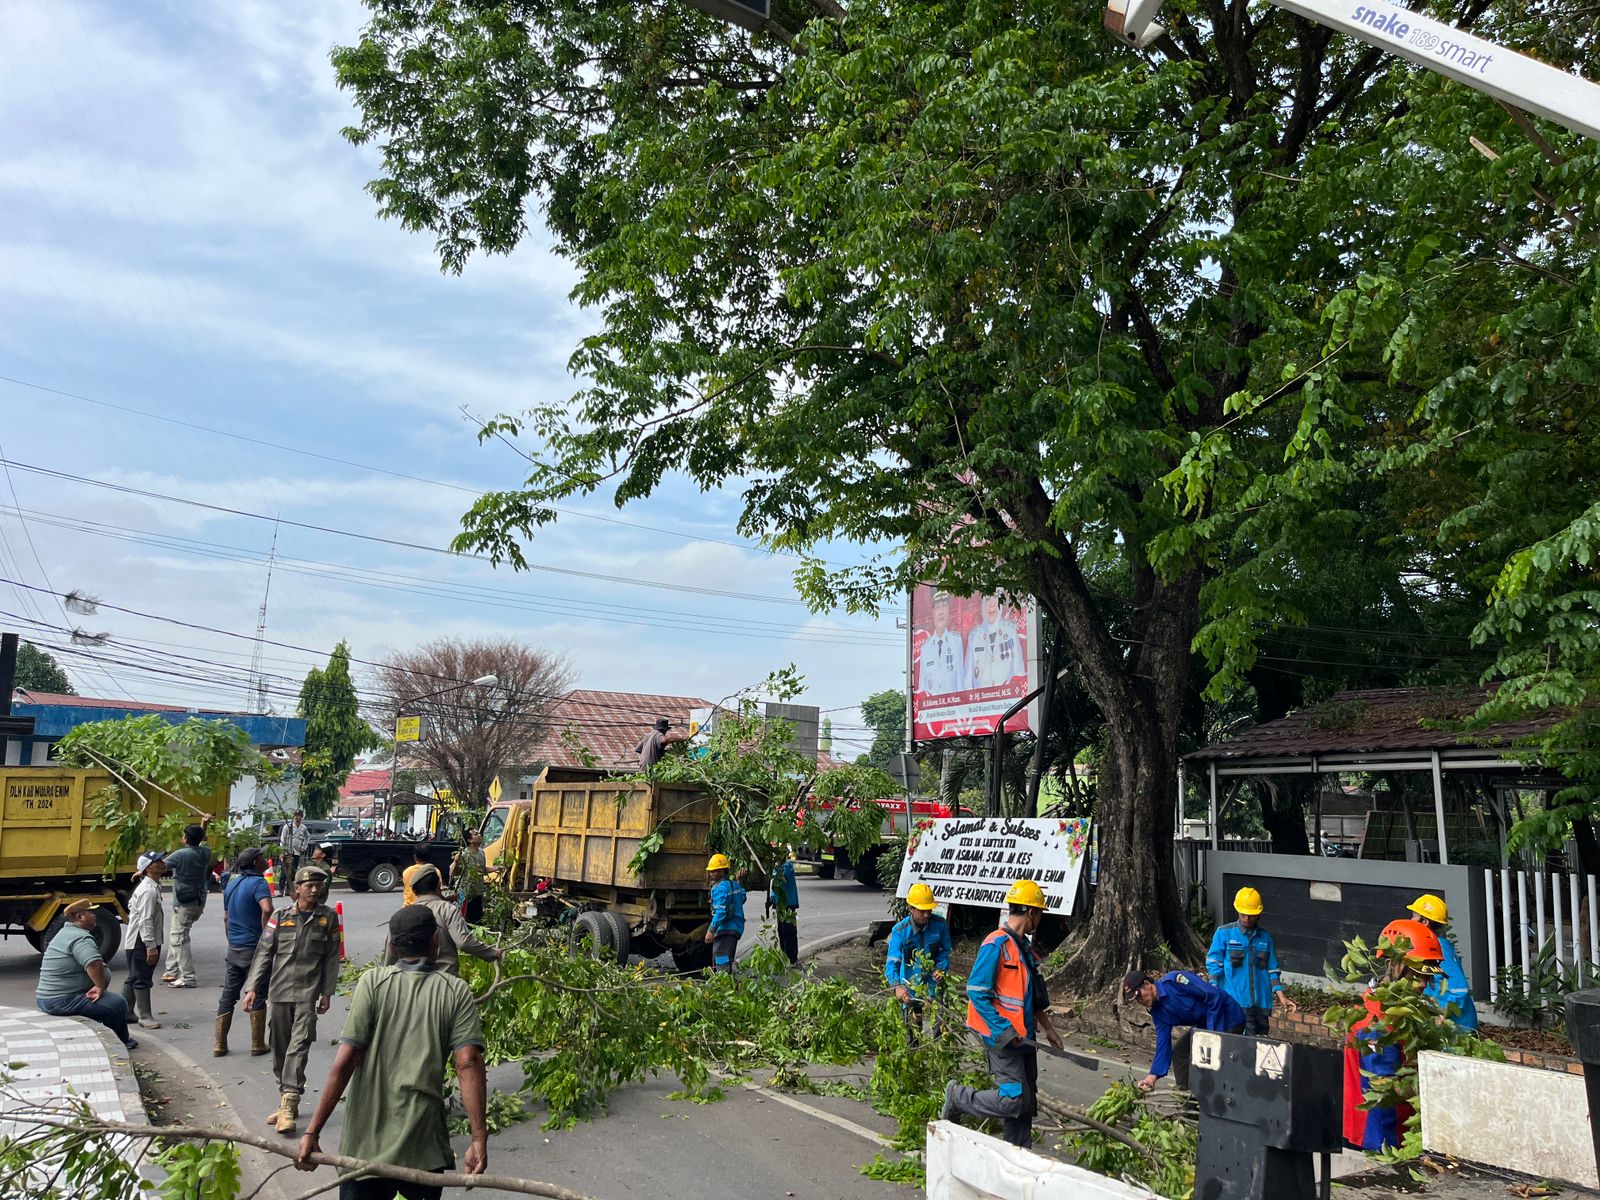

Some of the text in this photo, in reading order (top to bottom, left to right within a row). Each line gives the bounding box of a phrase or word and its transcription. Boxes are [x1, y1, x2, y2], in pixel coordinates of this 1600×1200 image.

[1351, 6, 1492, 73] snake 189 smart
[10, 786, 69, 797] DLH KAB MUARA ENIM
[38, 800, 52, 808] 2024
[942, 817, 1041, 841] Selamat & Sukses
[924, 862, 955, 875] DIREKTUR
[956, 864, 978, 877] RSUD
